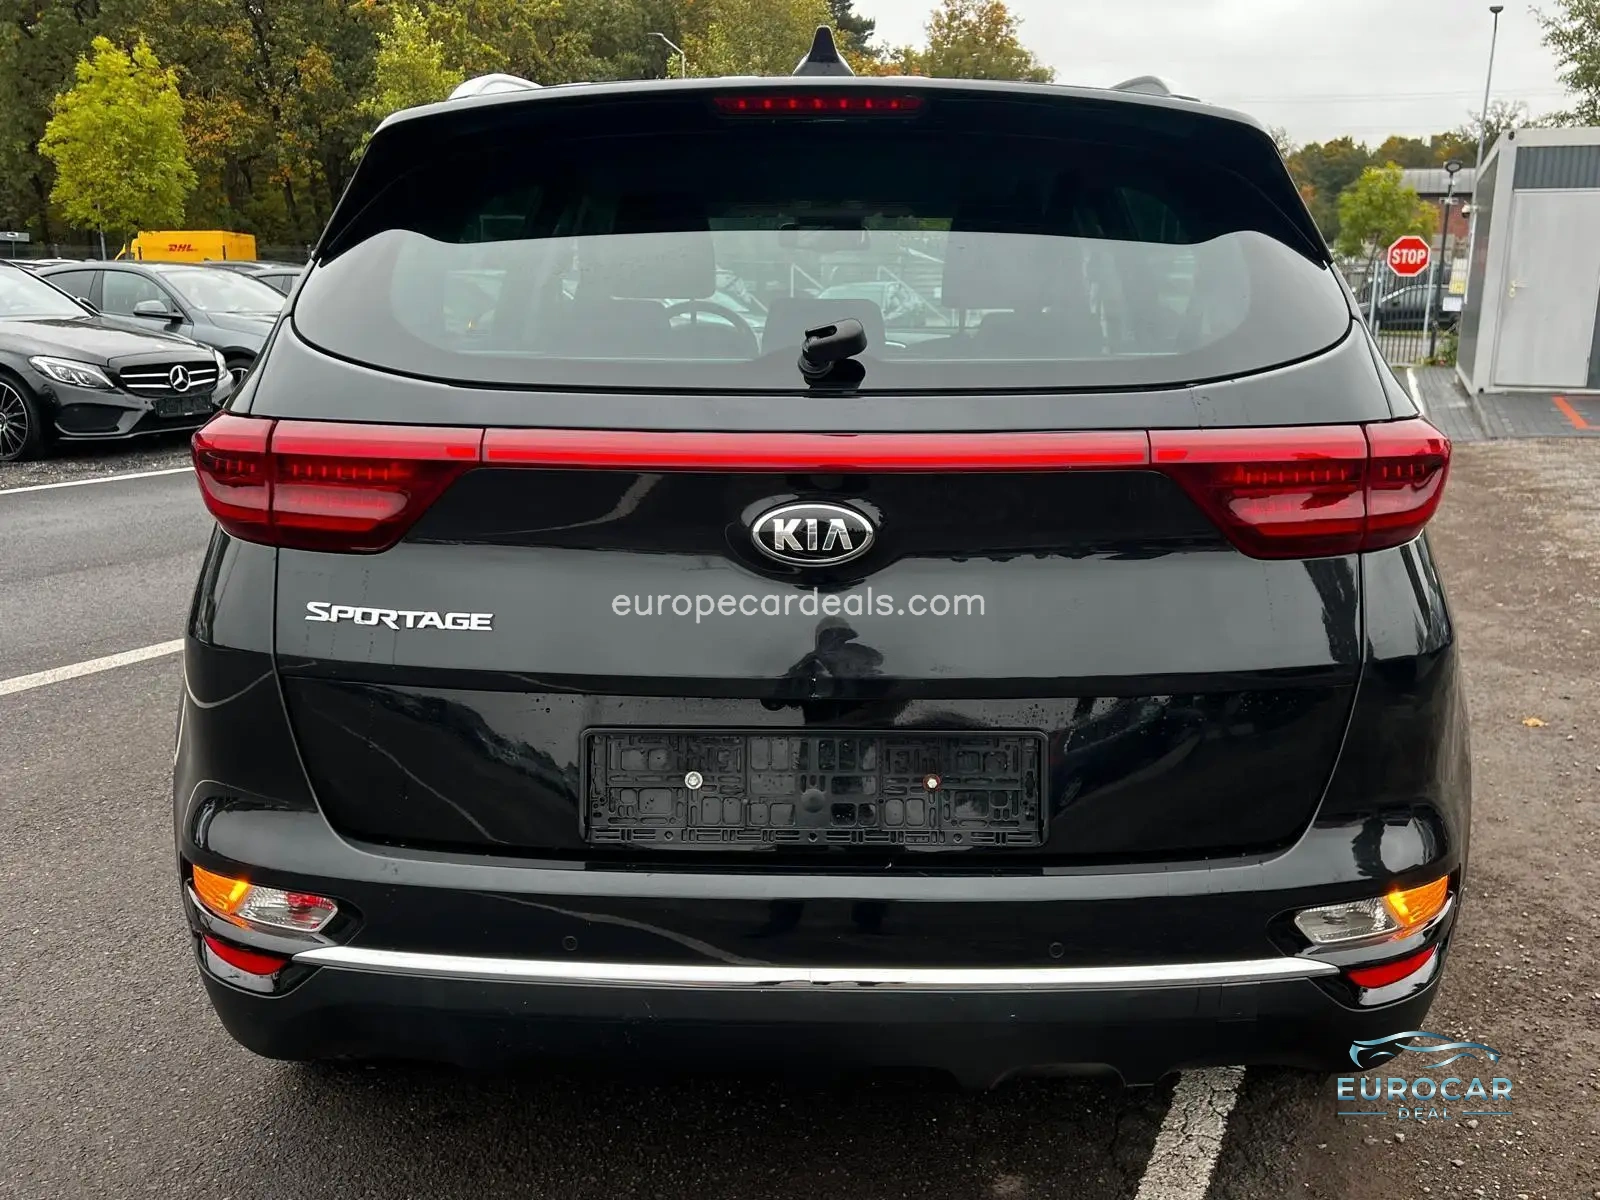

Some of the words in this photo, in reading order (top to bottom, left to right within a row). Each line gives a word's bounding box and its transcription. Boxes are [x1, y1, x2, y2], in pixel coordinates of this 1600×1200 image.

[168, 244, 194, 252] DHL
[1391, 248, 1426, 265] STOP
[772, 518, 854, 551] KIA
[304, 601, 494, 631] SPORTAGE
